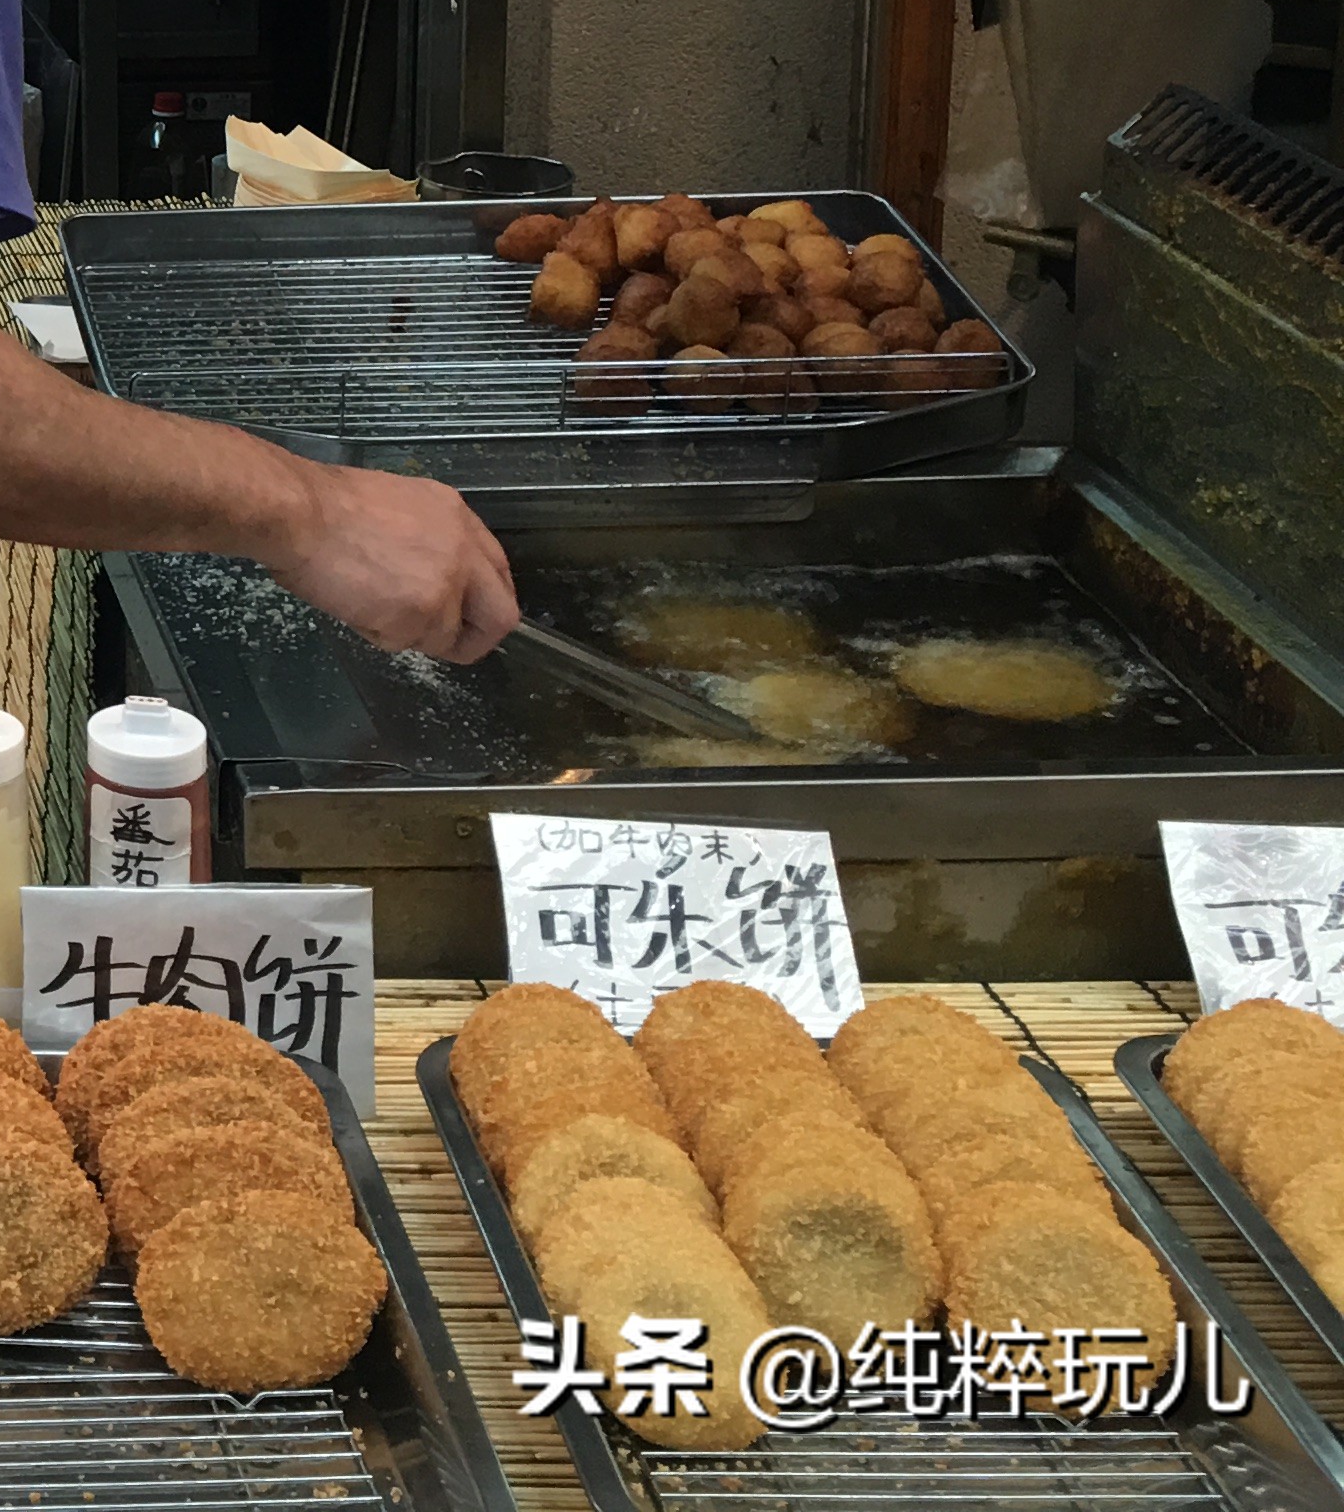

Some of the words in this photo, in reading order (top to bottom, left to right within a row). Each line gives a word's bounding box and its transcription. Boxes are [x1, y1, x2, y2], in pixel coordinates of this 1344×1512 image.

[109, 803, 175, 888] 番茄
[40, 925, 360, 1071] 牛肉饼
